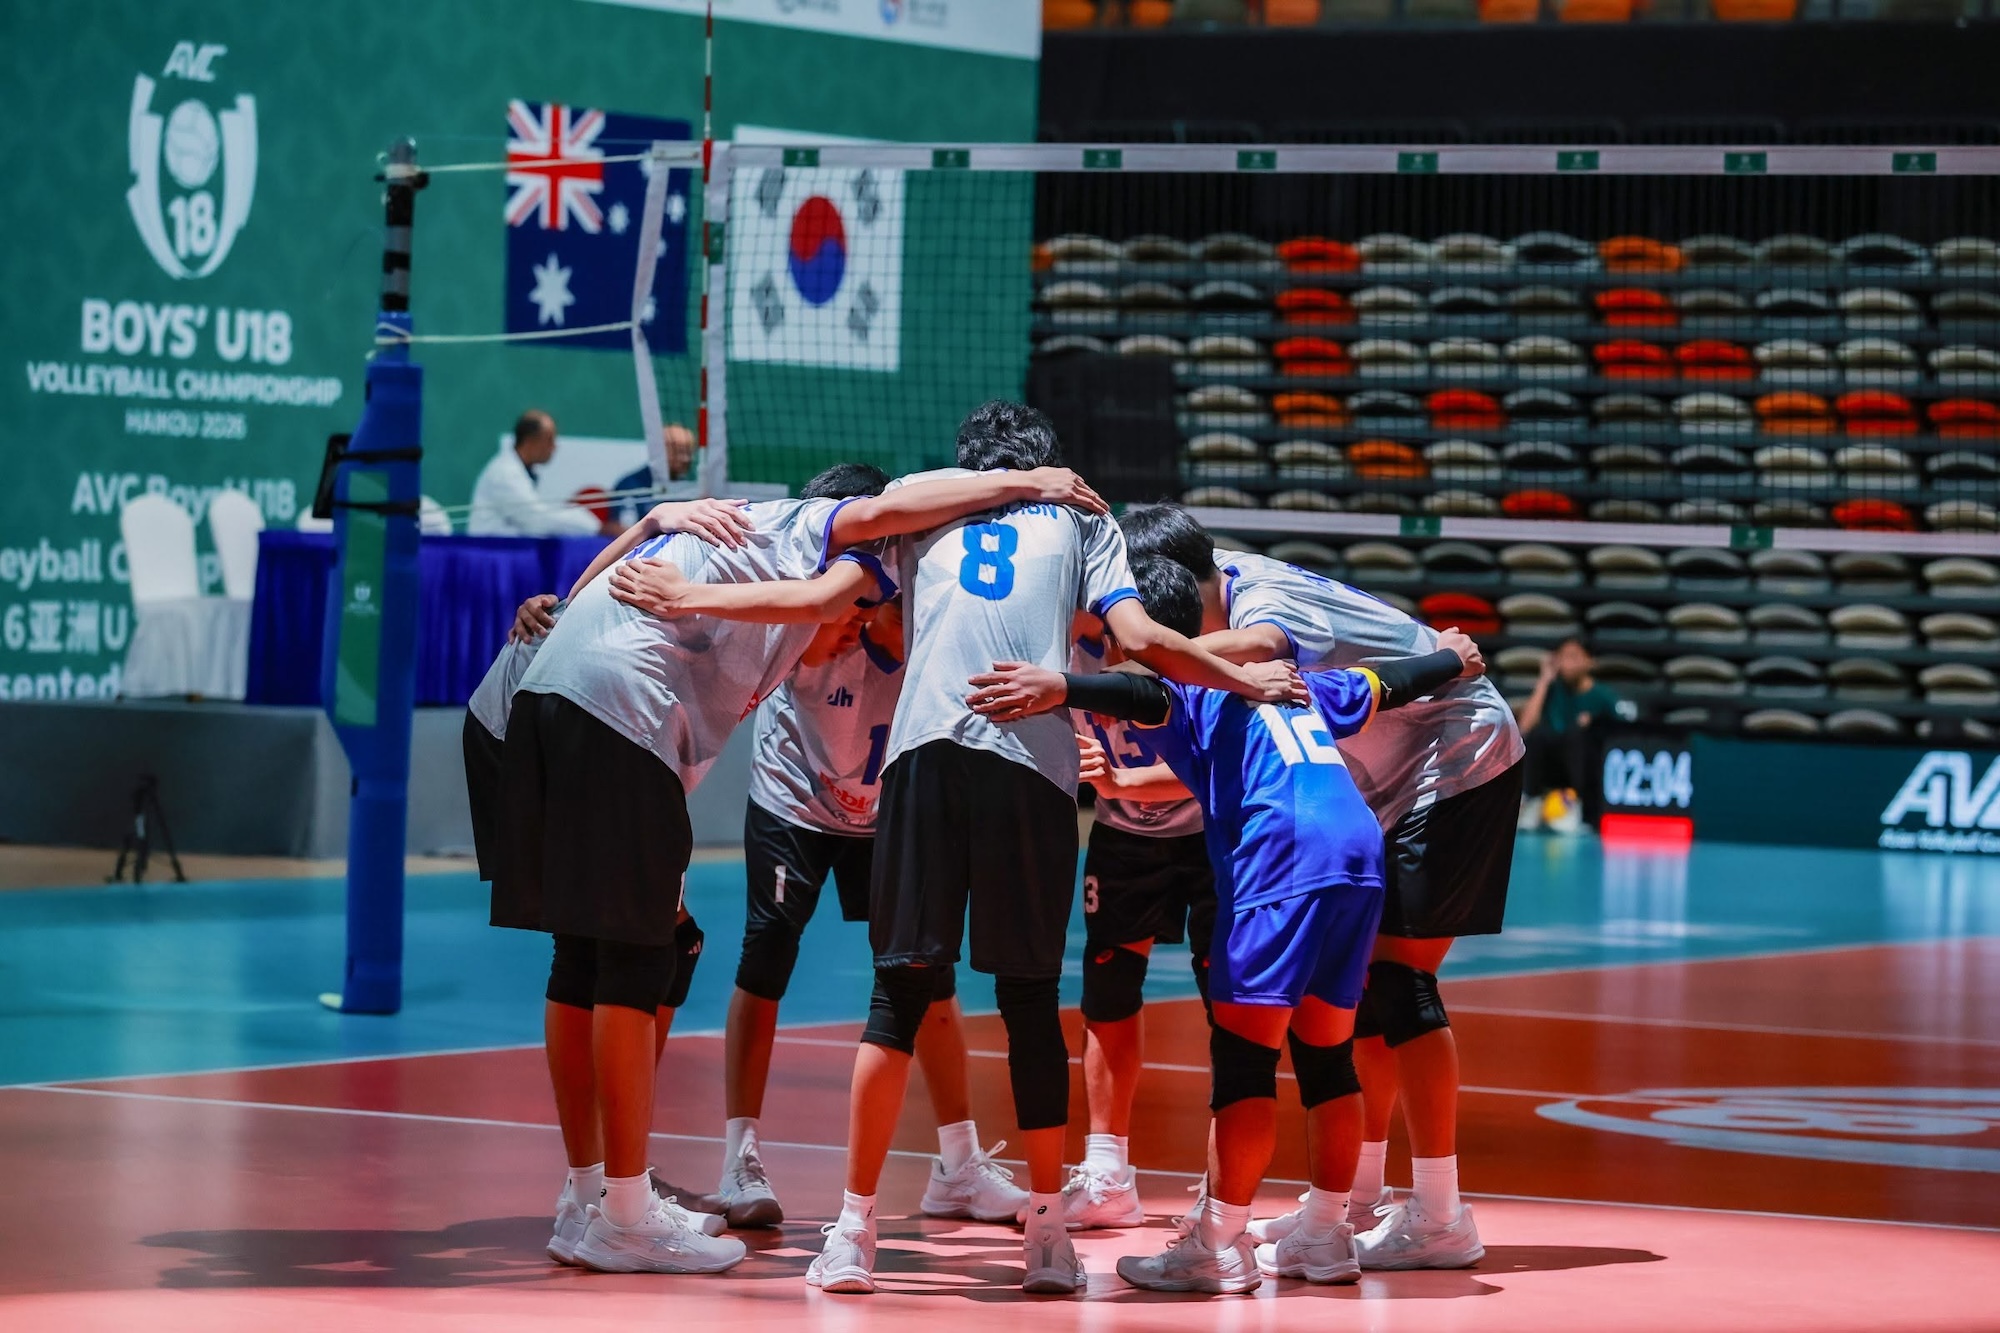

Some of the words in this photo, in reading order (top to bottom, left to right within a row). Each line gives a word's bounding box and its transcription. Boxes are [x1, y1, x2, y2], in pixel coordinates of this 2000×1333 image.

[162, 41, 228, 82] AVC
[169, 191, 216, 259] 18
[216, 307, 292, 366] U18
[27, 362, 172, 398] VOLLEYBALL
[175, 369, 343, 407] CHAMPIONSHIP
[959, 522, 1018, 601] 8
[861, 724, 889, 785] 1
[1603, 748, 1693, 808] 02:04
[775, 865, 787, 903] 1
[1084, 874, 1099, 914] 3
